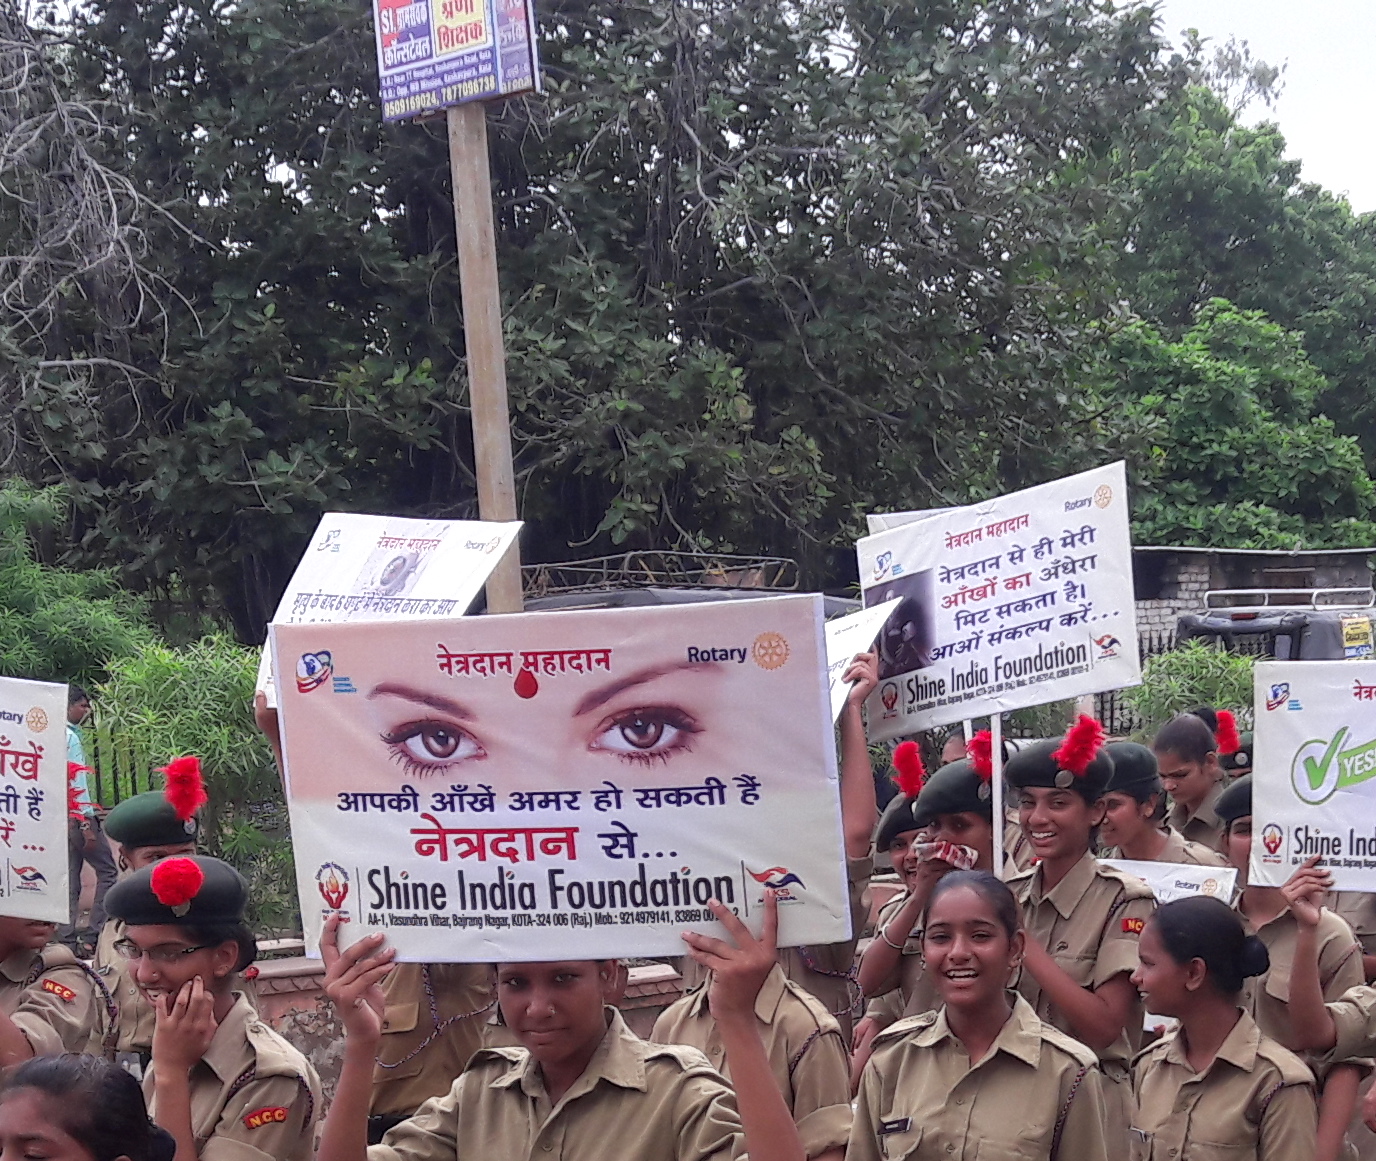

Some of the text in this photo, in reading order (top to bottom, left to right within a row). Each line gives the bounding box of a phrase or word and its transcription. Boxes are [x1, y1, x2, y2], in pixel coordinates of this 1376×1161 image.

[1064, 495, 1093, 513] Rotary
[945, 514, 1030, 550] नेत्रदान महादान
[938, 525, 1096, 585] नेत्रदान से ही मेरी
[941, 553, 1098, 610] आँखों का अँधेरा
[953, 588, 1057, 631] मिट सकता
[987, 616, 1050, 649] संकल्प
[436, 643, 612, 675] नेत्रदान महादान
[687, 644, 748, 665] Rotary
[906, 674, 946, 704] Shine
[951, 659, 988, 693] India
[994, 642, 1087, 682] Foundation
[24, 787, 44, 822] हैं
[336, 773, 763, 815] आपकी आँखें अमर हो सकती हैं
[409, 813, 579, 864] नेत्रदान
[1293, 827, 1342, 856] Shine
[367, 866, 447, 912] Shine
[458, 865, 536, 910] India
[548, 864, 733, 911] Foundation
[552, 913, 568, 926] 006
[1128, 919, 1143, 932] NC
[45, 982, 71, 998] NCC
[249, 1109, 285, 1127] NCC
